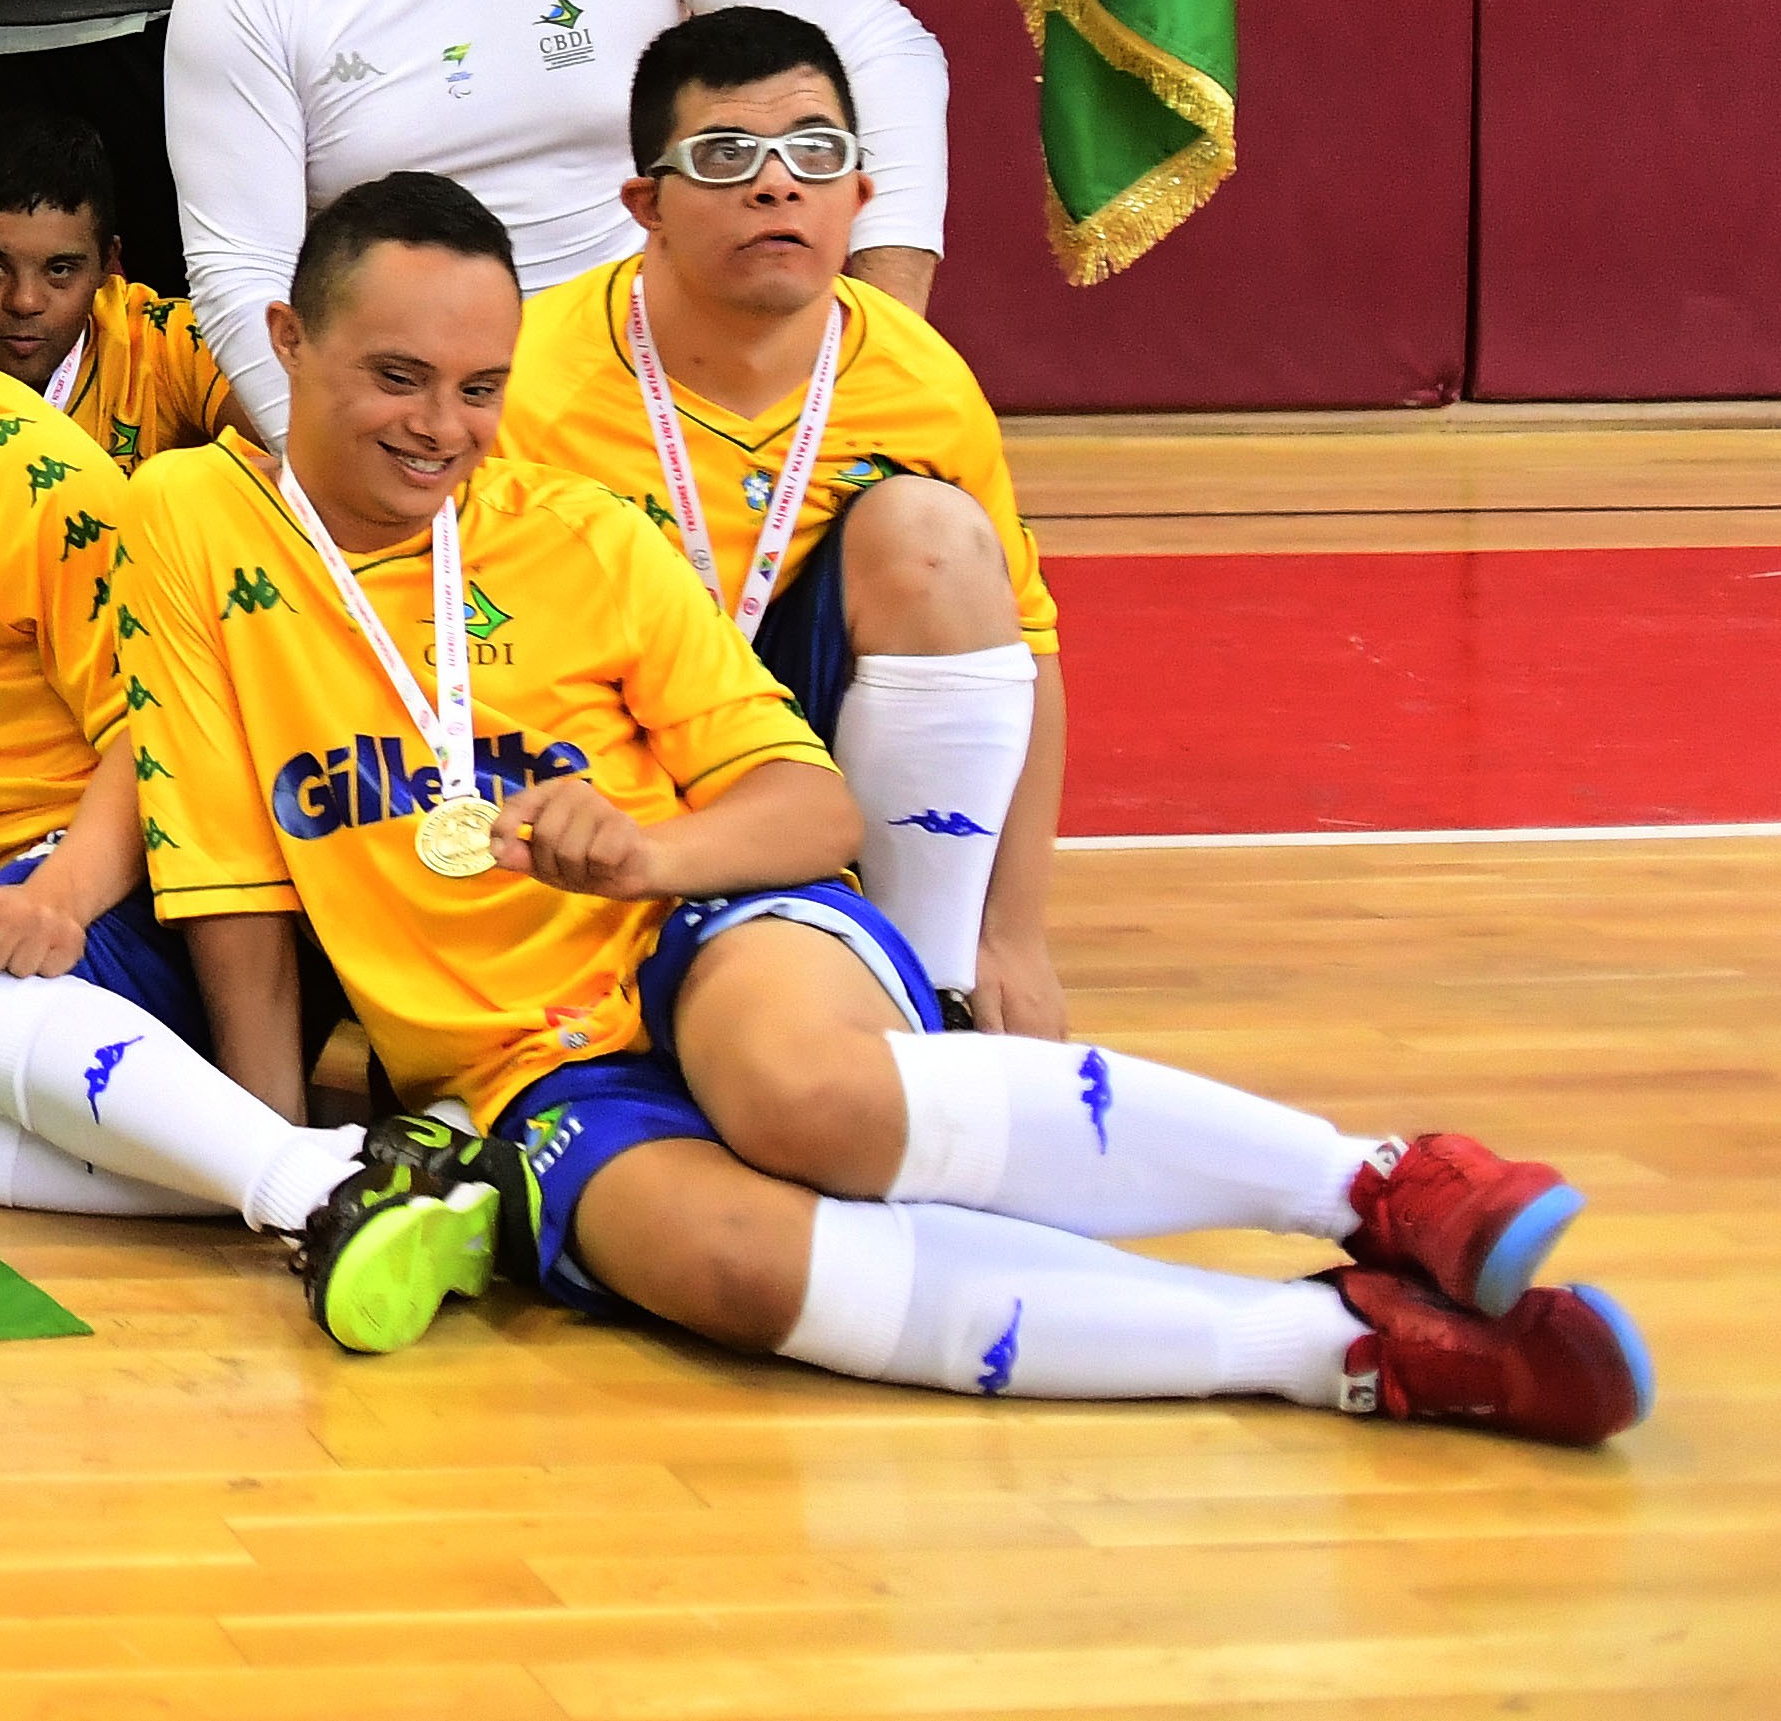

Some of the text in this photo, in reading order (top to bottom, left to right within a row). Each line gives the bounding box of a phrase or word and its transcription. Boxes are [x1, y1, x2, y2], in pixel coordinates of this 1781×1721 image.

[539, 29, 592, 54] CBDI
[640, 352, 662, 401] ANTALYA
[790, 424, 814, 473] ANTALYA
